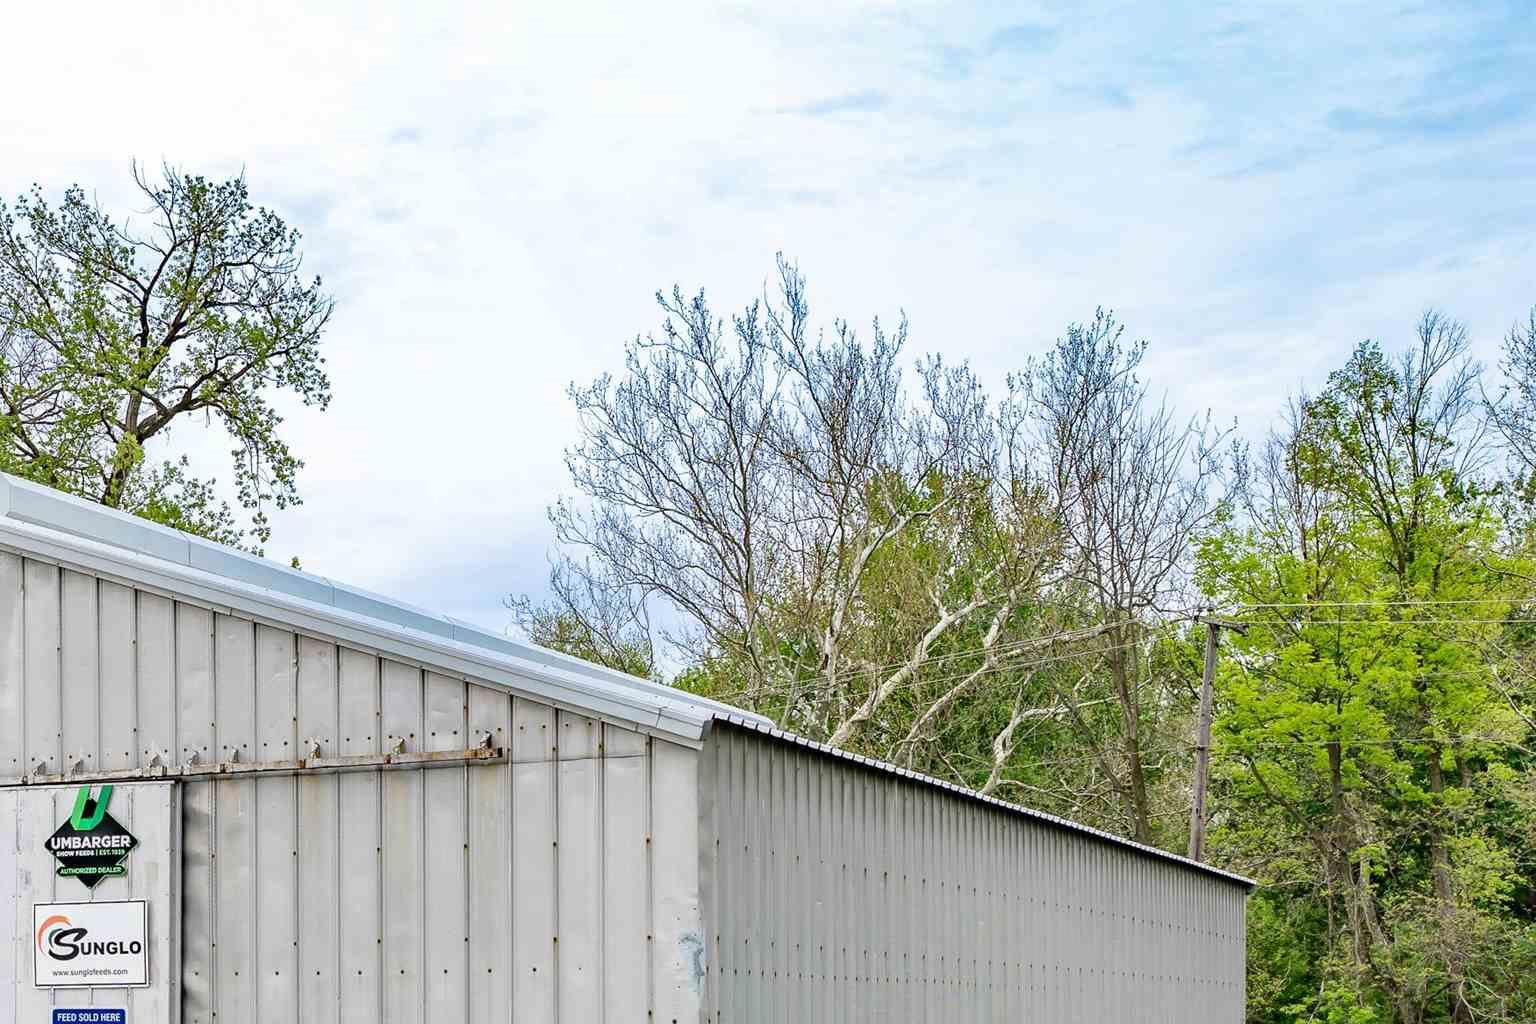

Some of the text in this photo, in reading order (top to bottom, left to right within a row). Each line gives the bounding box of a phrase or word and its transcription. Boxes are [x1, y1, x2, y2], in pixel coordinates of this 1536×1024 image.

[50, 835, 132, 850] UMBARGER
[75, 849, 95, 857] FEEDS
[59, 865, 123, 874] AUTHORIZED DEALER
[48, 927, 142, 961] SUNGLO
[52, 968, 129, 978] www.sunglofeeds.com
[57, 1012, 121, 1022] FEED SOLD HERE
